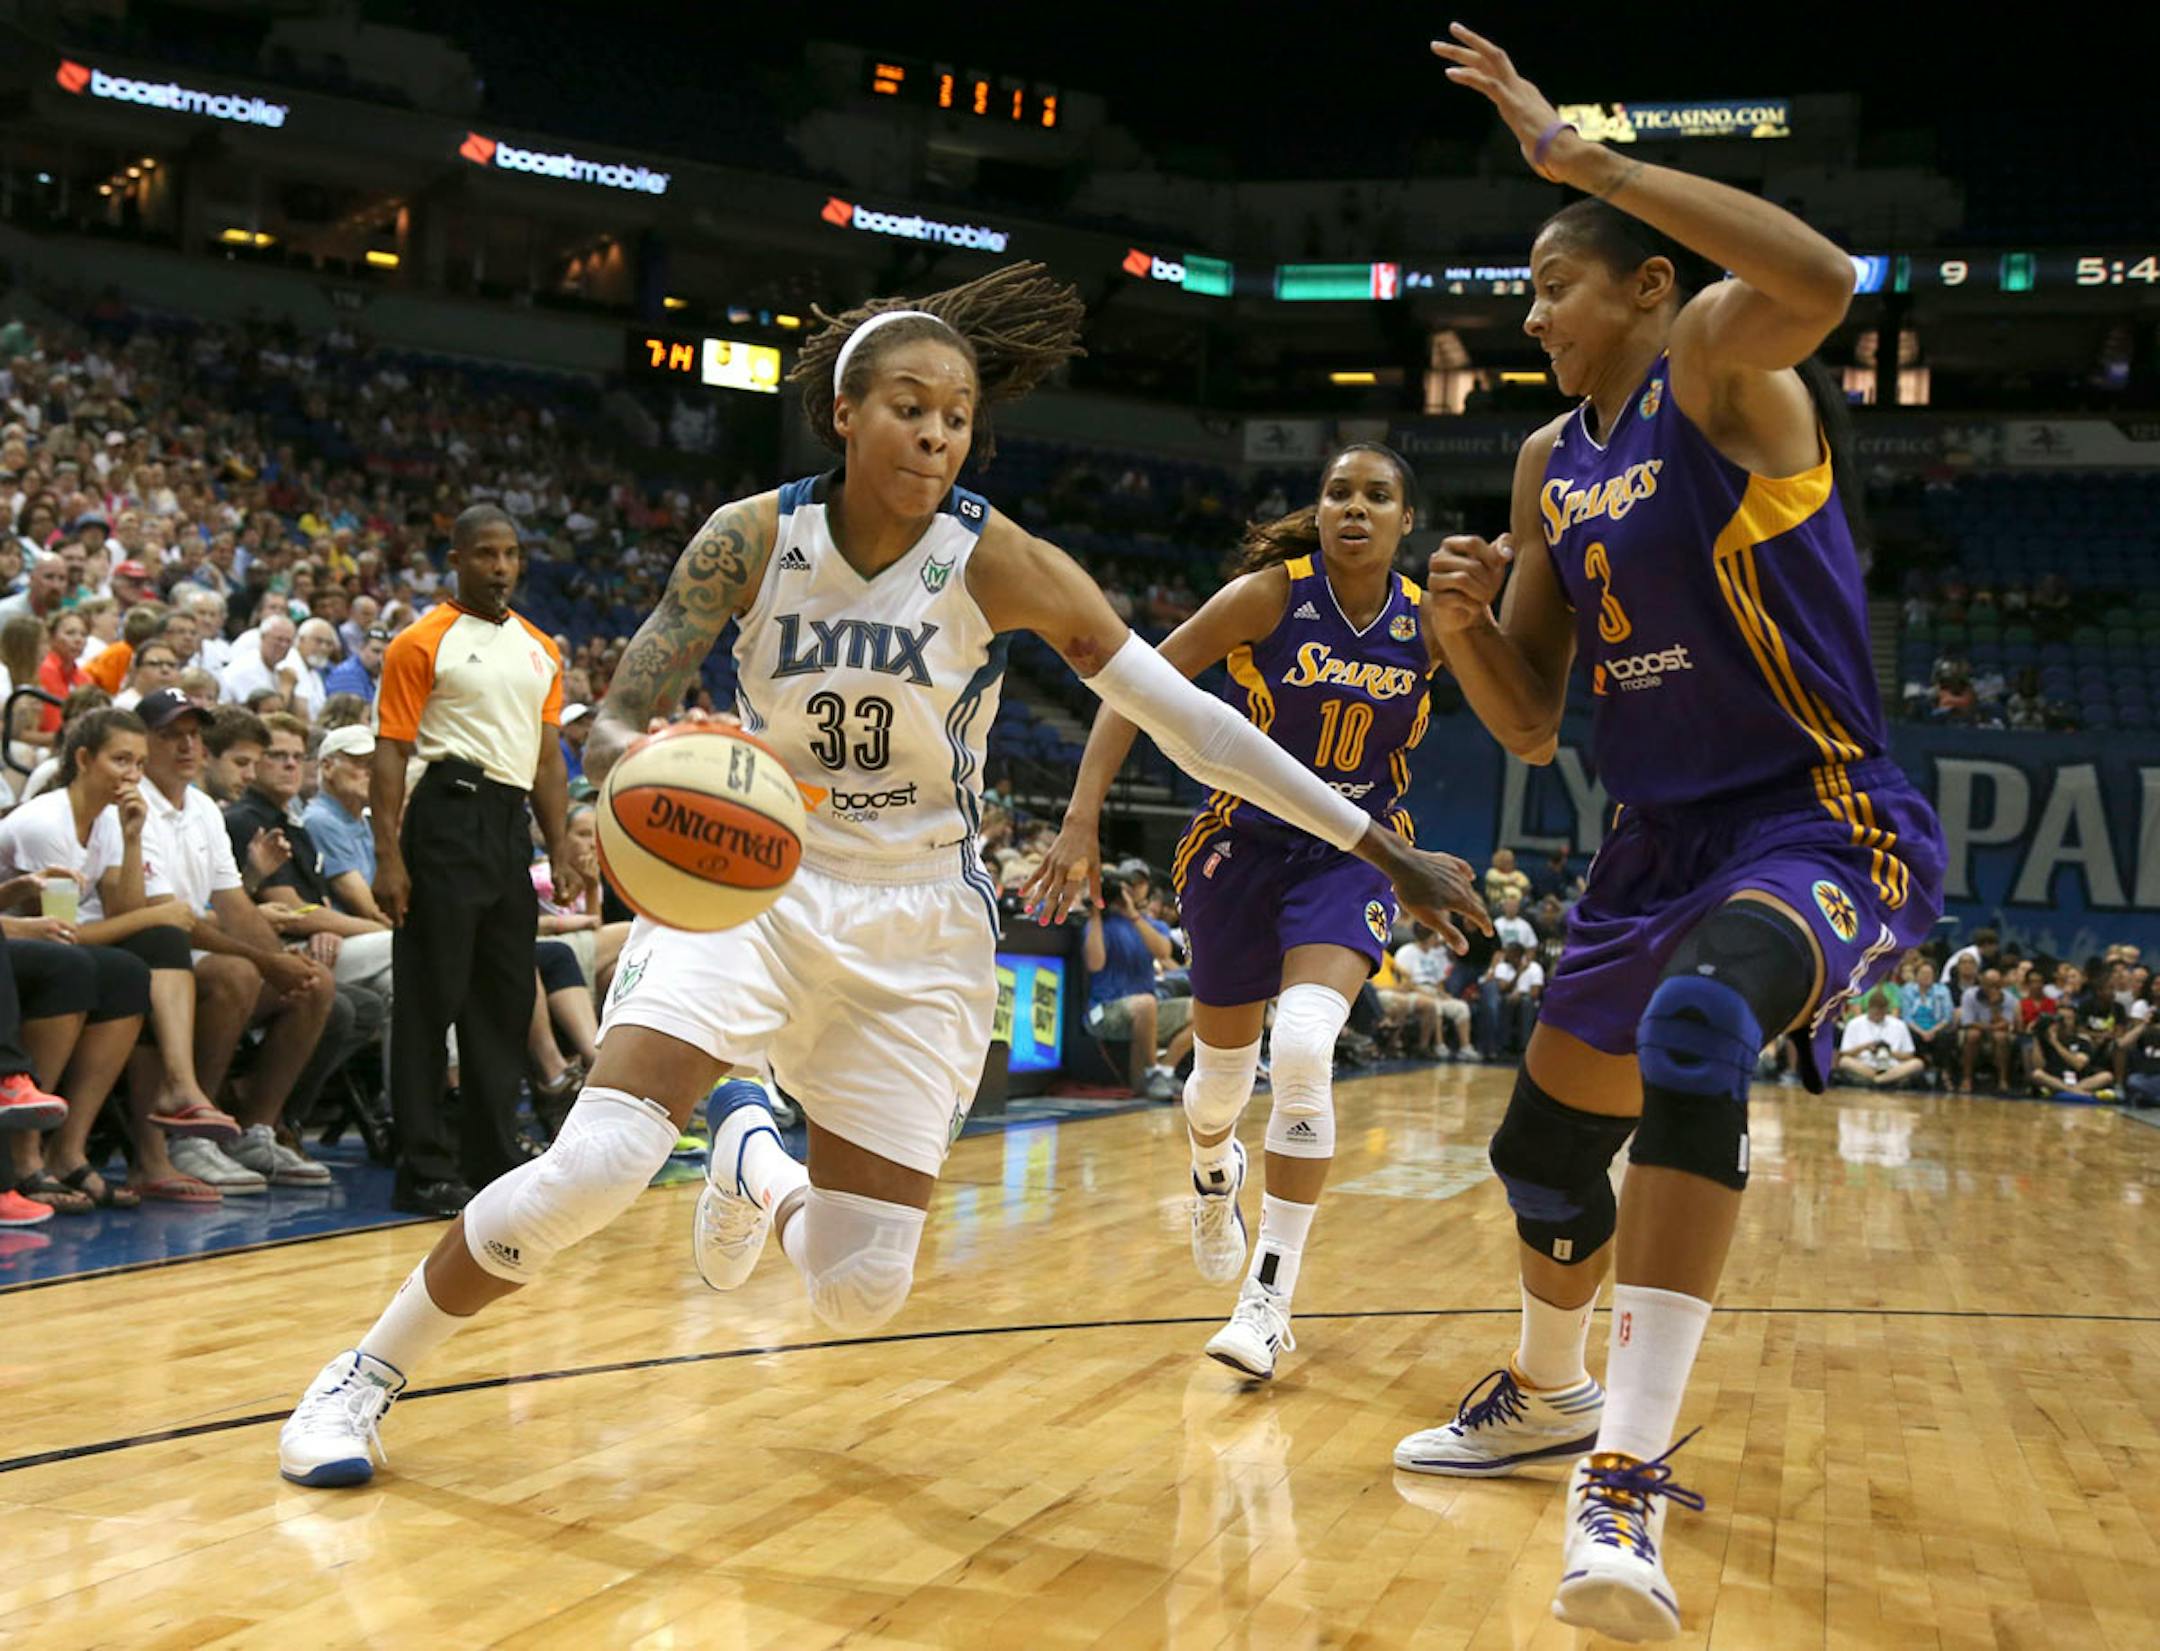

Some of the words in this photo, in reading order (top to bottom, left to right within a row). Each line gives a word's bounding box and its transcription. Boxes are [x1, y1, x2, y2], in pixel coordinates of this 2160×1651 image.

[91, 68, 289, 128] boostmobile
[1632, 107, 1785, 129] TICASINO.COM
[496, 141, 671, 194] boostmobile
[853, 205, 1009, 253] boostmobile
[1940, 260, 1968, 286] 9
[959, 500, 984, 519] CS
[1585, 542, 1632, 643] 3
[770, 614, 940, 687] LYNX
[1606, 644, 1693, 681] boost
[1620, 676, 1663, 692] mobile
[806, 691, 893, 772] 33
[1314, 699, 1375, 772] 10
[830, 782, 919, 811] boost
[831, 810, 880, 823] mobile
[646, 793, 789, 871] SPALDING
